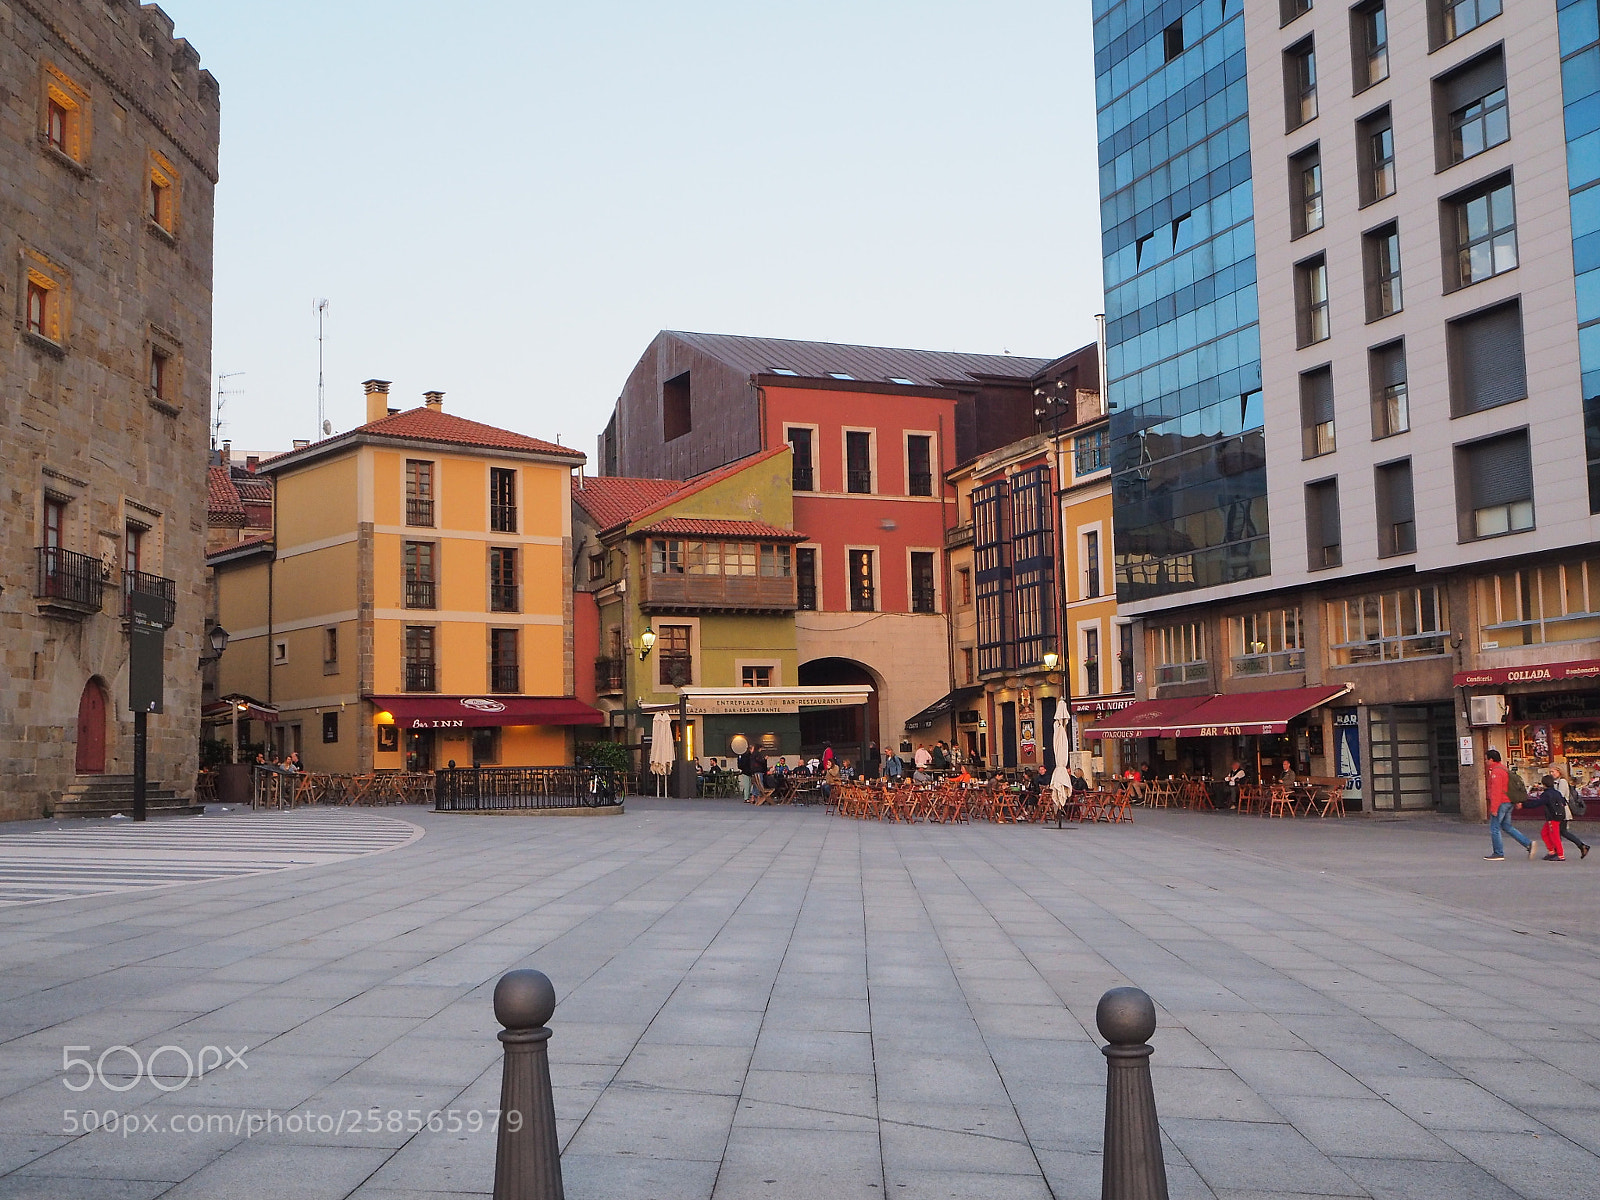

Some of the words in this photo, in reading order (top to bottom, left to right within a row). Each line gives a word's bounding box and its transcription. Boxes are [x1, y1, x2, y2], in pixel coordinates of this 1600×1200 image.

[1508, 668, 1550, 680] COLLADA
[412, 719, 428, 728] Bar
[432, 720, 464, 728] INN
[1336, 714, 1357, 723] BAR
[1200, 727, 1218, 737] BAR
[1223, 726, 1242, 736] 4.70
